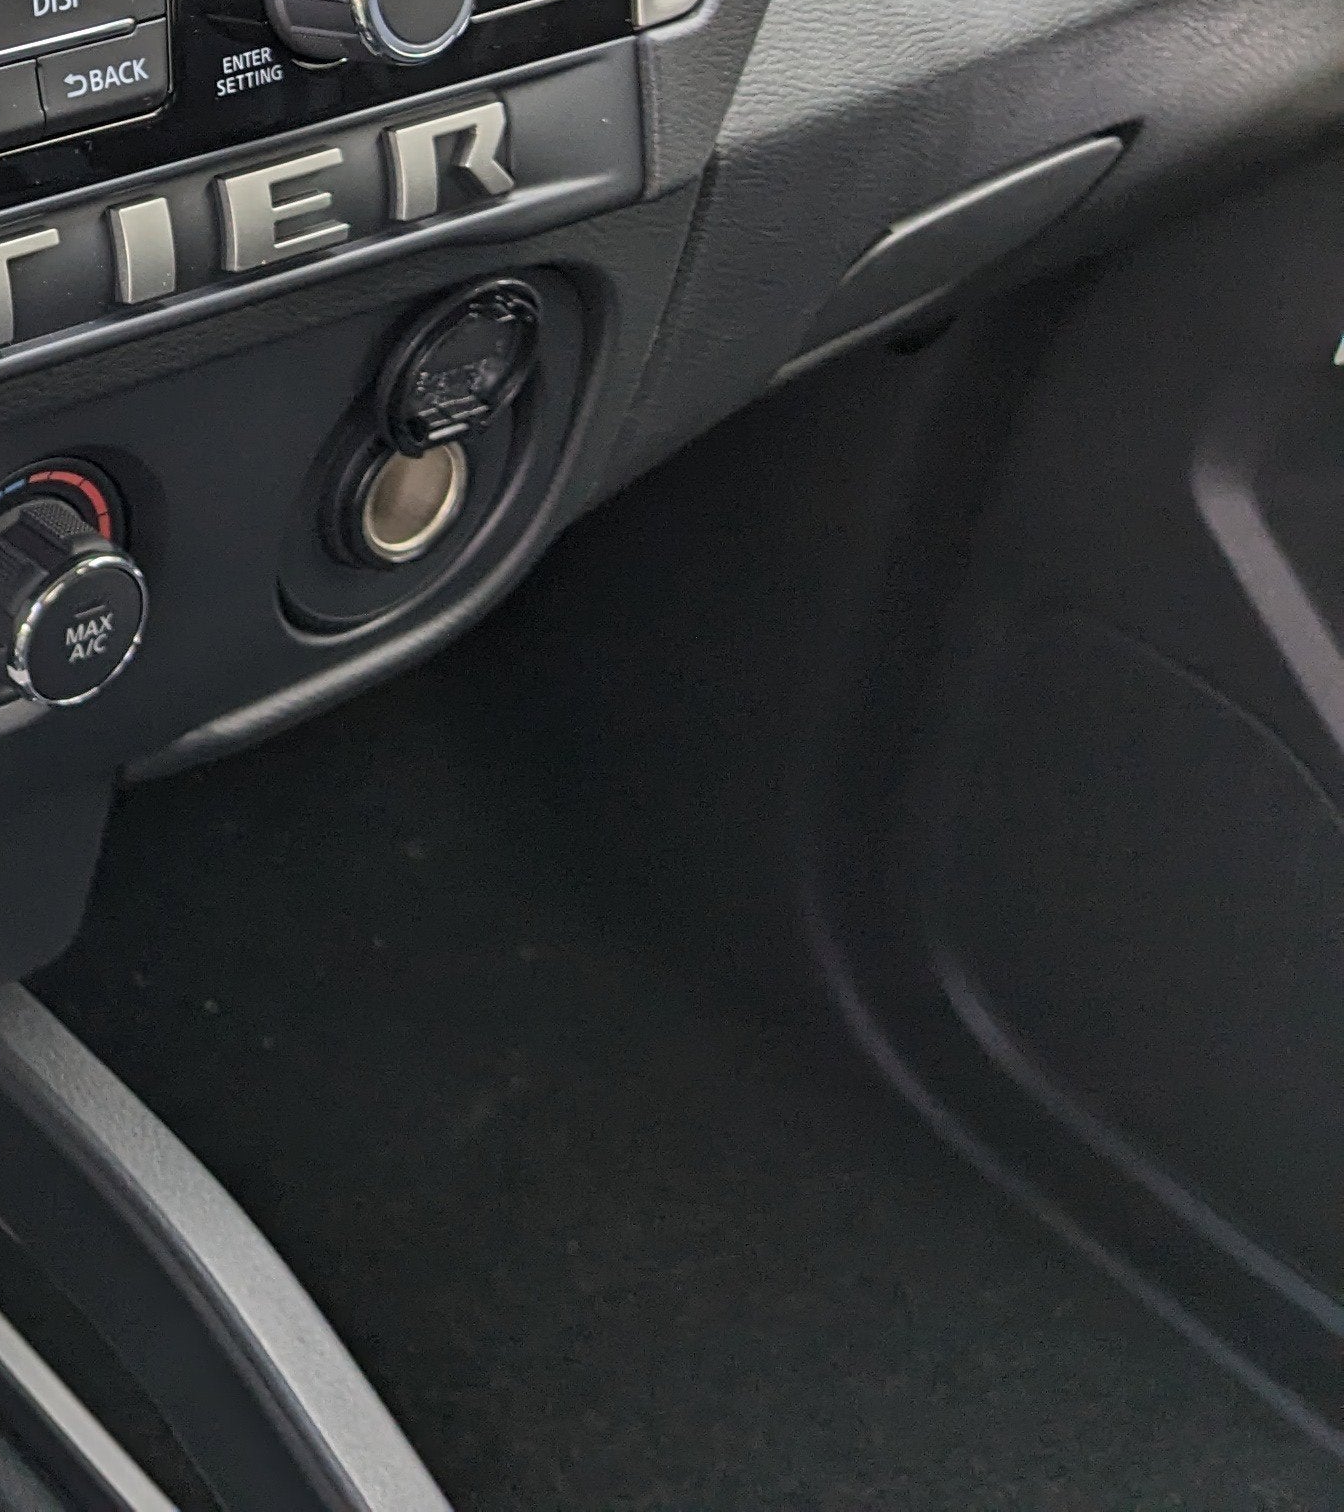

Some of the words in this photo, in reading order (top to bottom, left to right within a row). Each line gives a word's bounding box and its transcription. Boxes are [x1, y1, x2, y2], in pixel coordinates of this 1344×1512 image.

[90, 57, 149, 94] BACK
[223, 47, 272, 75] ENTER
[216, 64, 283, 98] SETTING
[64, 613, 114, 648] MAX
[68, 633, 109, 662] A/C
